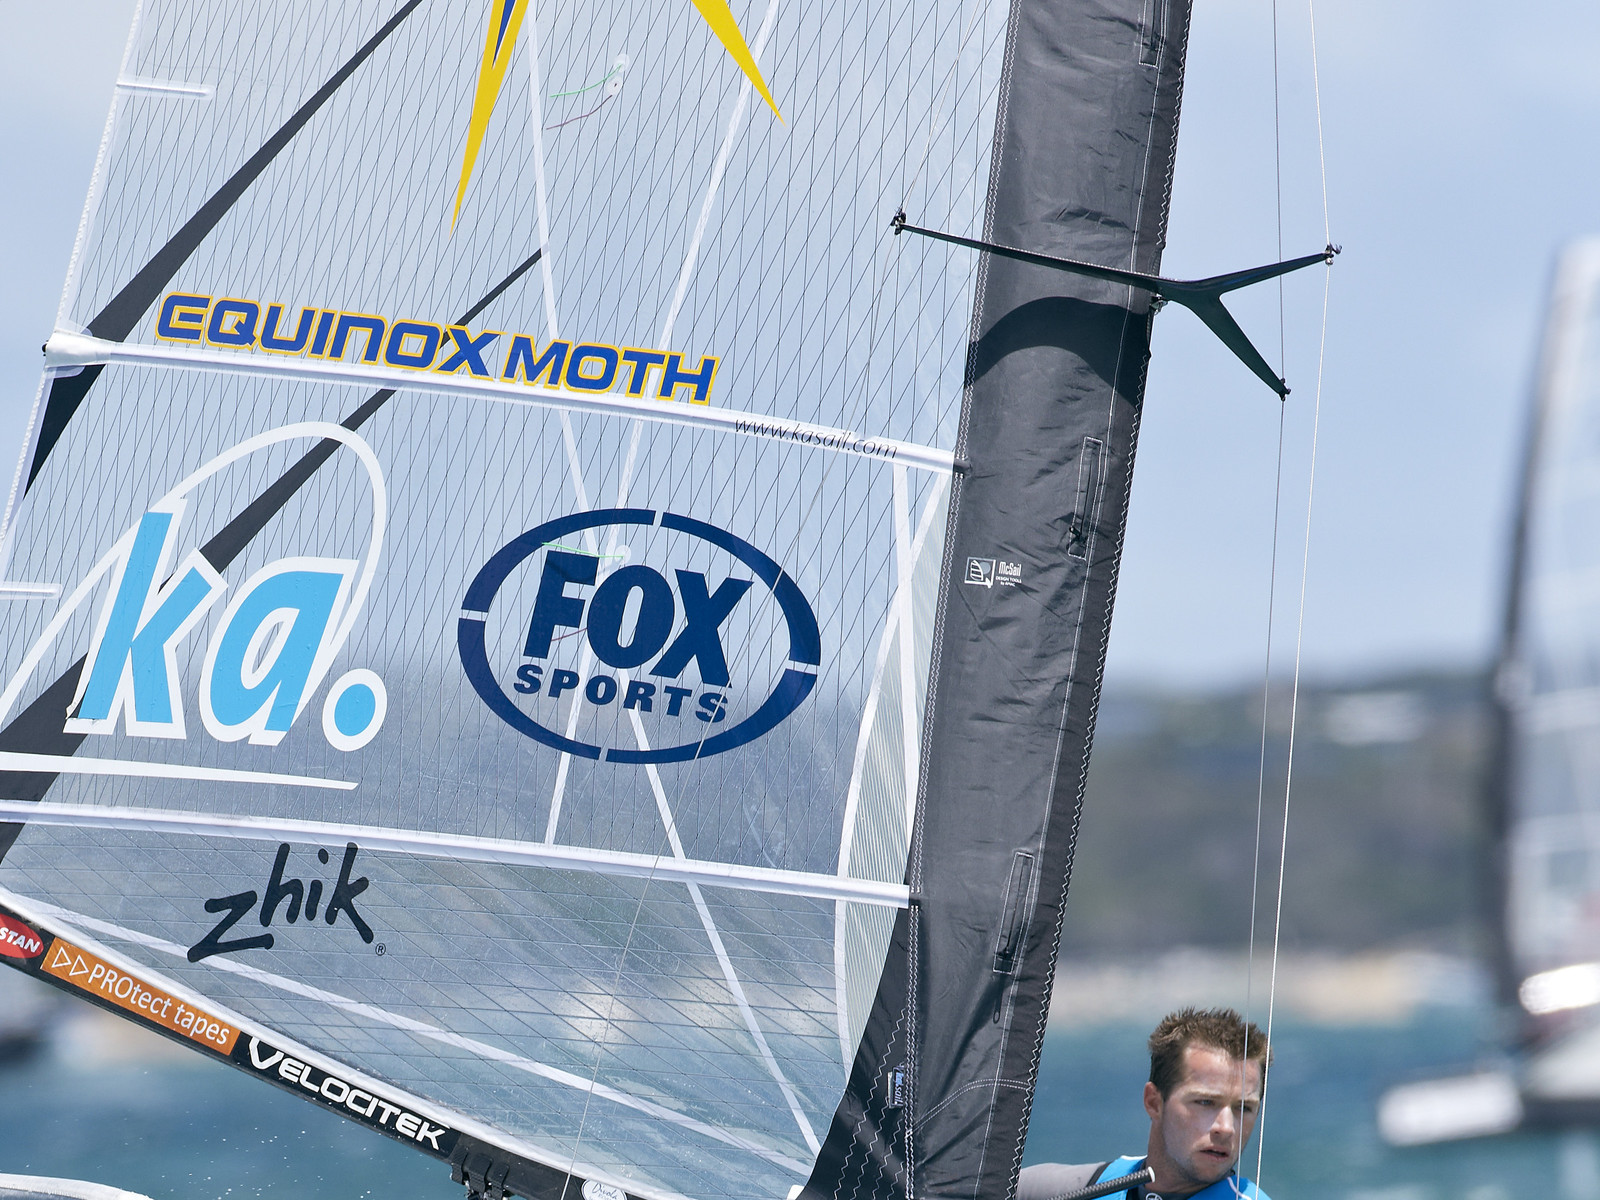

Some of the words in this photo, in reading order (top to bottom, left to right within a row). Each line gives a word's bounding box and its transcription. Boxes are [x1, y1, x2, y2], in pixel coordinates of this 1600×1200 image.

[155, 290, 506, 383] EQUINOX
[501, 332, 720, 406] MOTH
[734, 416, 898, 460] www.kasail.com
[523, 550, 753, 688] FOX
[513, 663, 729, 724] SPORTS
[187, 842, 374, 963] zhik
[89, 965, 173, 1021] PROtect
[174, 1004, 231, 1045] tapes
[248, 1036, 447, 1151] VELOCITEK
